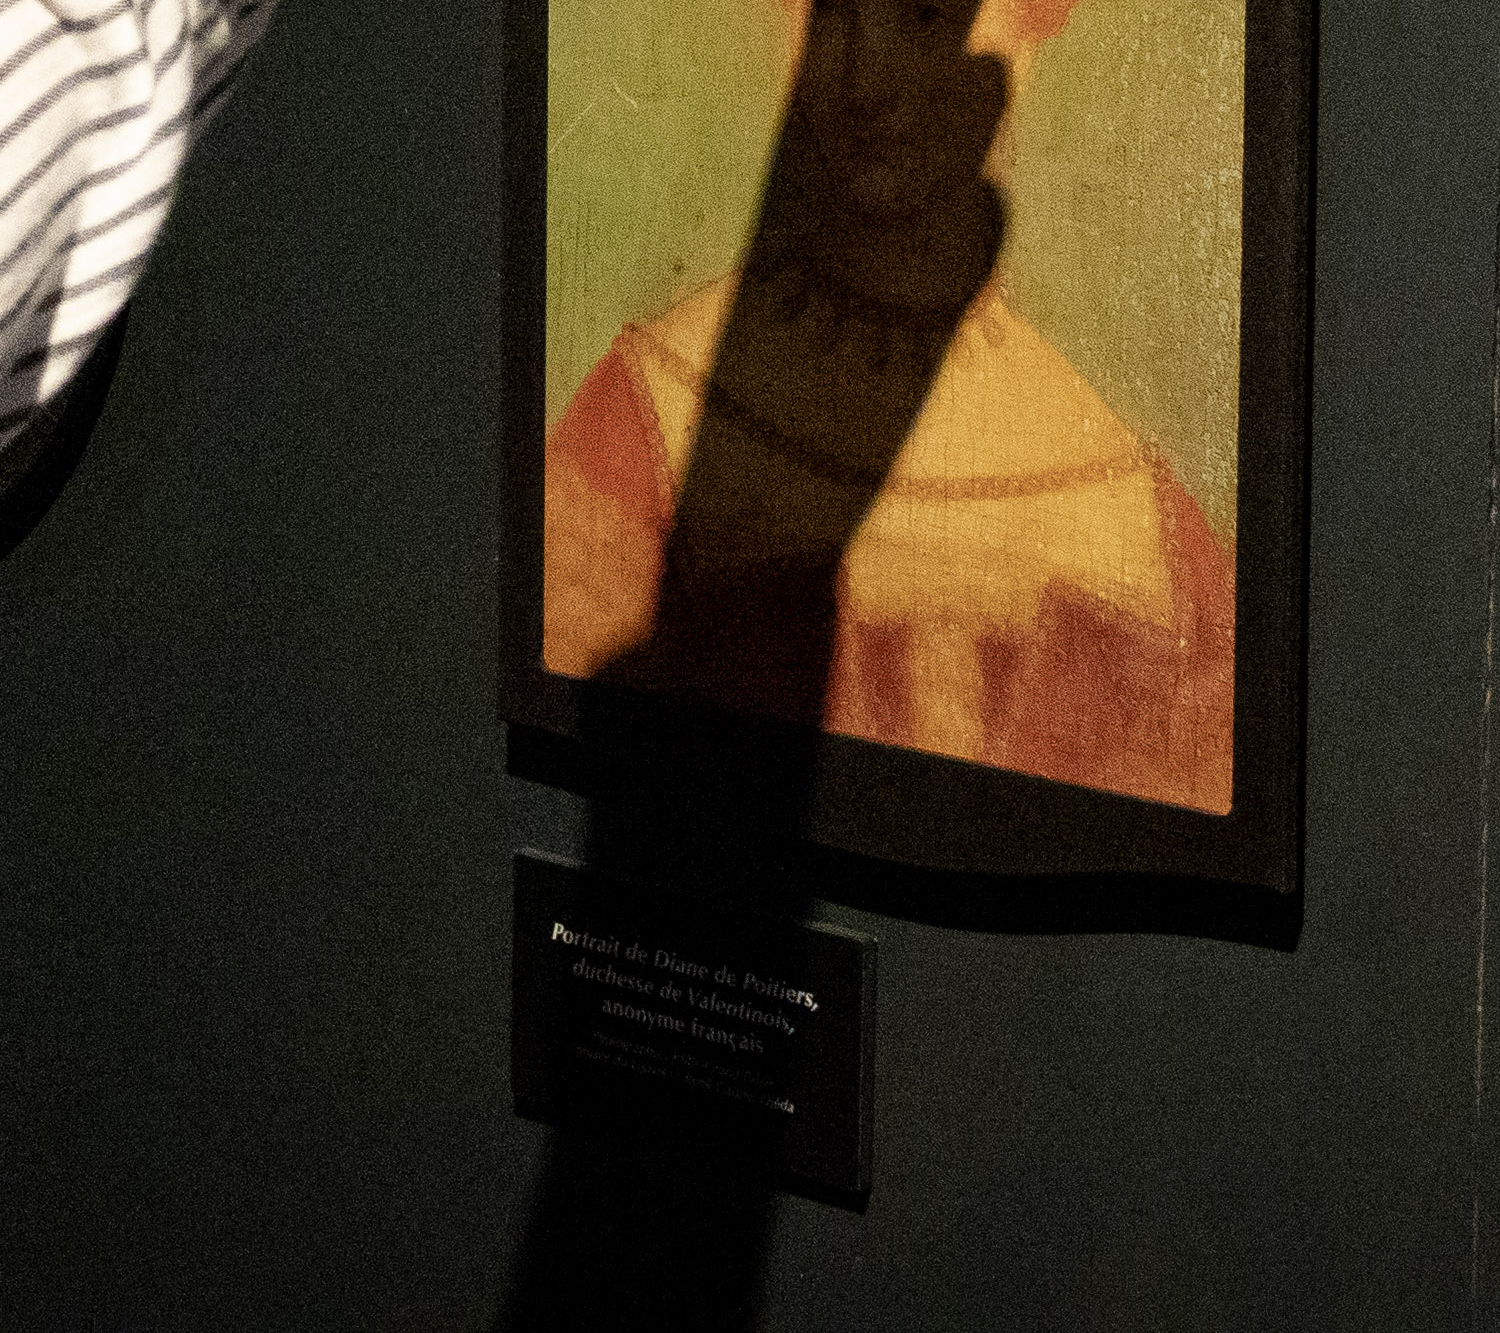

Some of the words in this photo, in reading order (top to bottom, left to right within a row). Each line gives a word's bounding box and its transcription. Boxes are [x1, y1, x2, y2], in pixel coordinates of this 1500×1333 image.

[550, 921, 620, 957] Portrait
[625, 941, 647, 963] de
[654, 949, 709, 979] Diane
[714, 965, 736, 986] de
[742, 972, 820, 1012] Poitiers,
[572, 958, 654, 995] duchesse
[659, 980, 683, 1003] de
[688, 986, 796, 1035] Valentinois,
[601, 998, 685, 1030] anonyme
[691, 1017, 764, 1053] français
